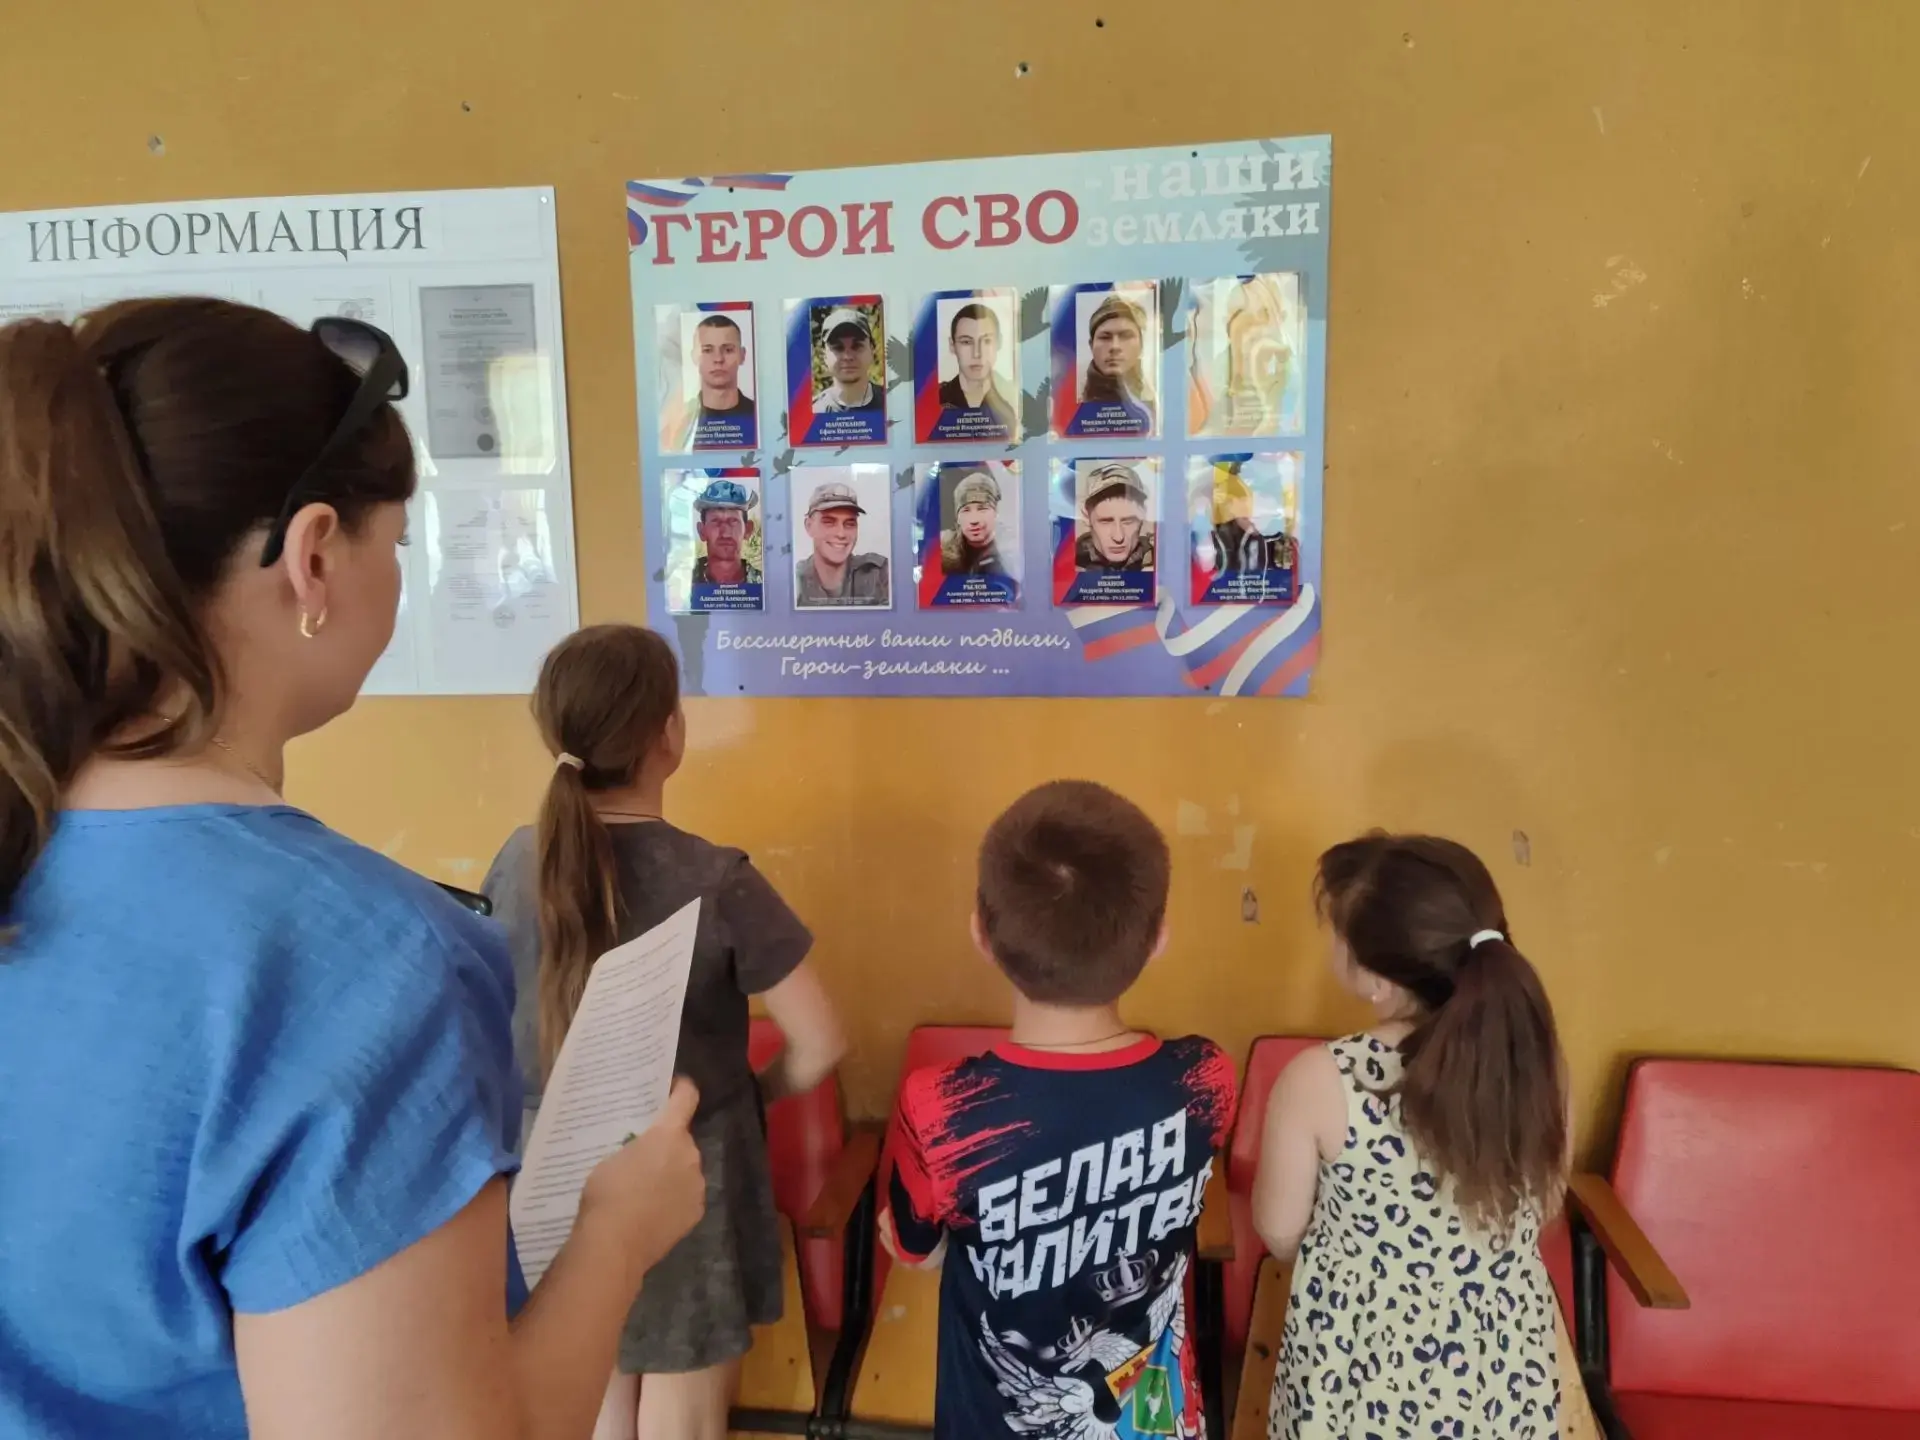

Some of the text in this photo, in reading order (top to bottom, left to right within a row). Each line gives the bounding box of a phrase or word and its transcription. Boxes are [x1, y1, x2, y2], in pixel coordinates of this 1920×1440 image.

[28, 206, 428, 263] ИНФОРМАЦИЯ
[650, 189, 1079, 265] ГЕРОИ СВО
[1085, 202, 1321, 247] земляки
[716, 628, 1071, 653] Бессмертны ваши подвиги,
[780, 656, 987, 680] Герои-земляки
[977, 1107, 1187, 1243] БЕЛАЯ
